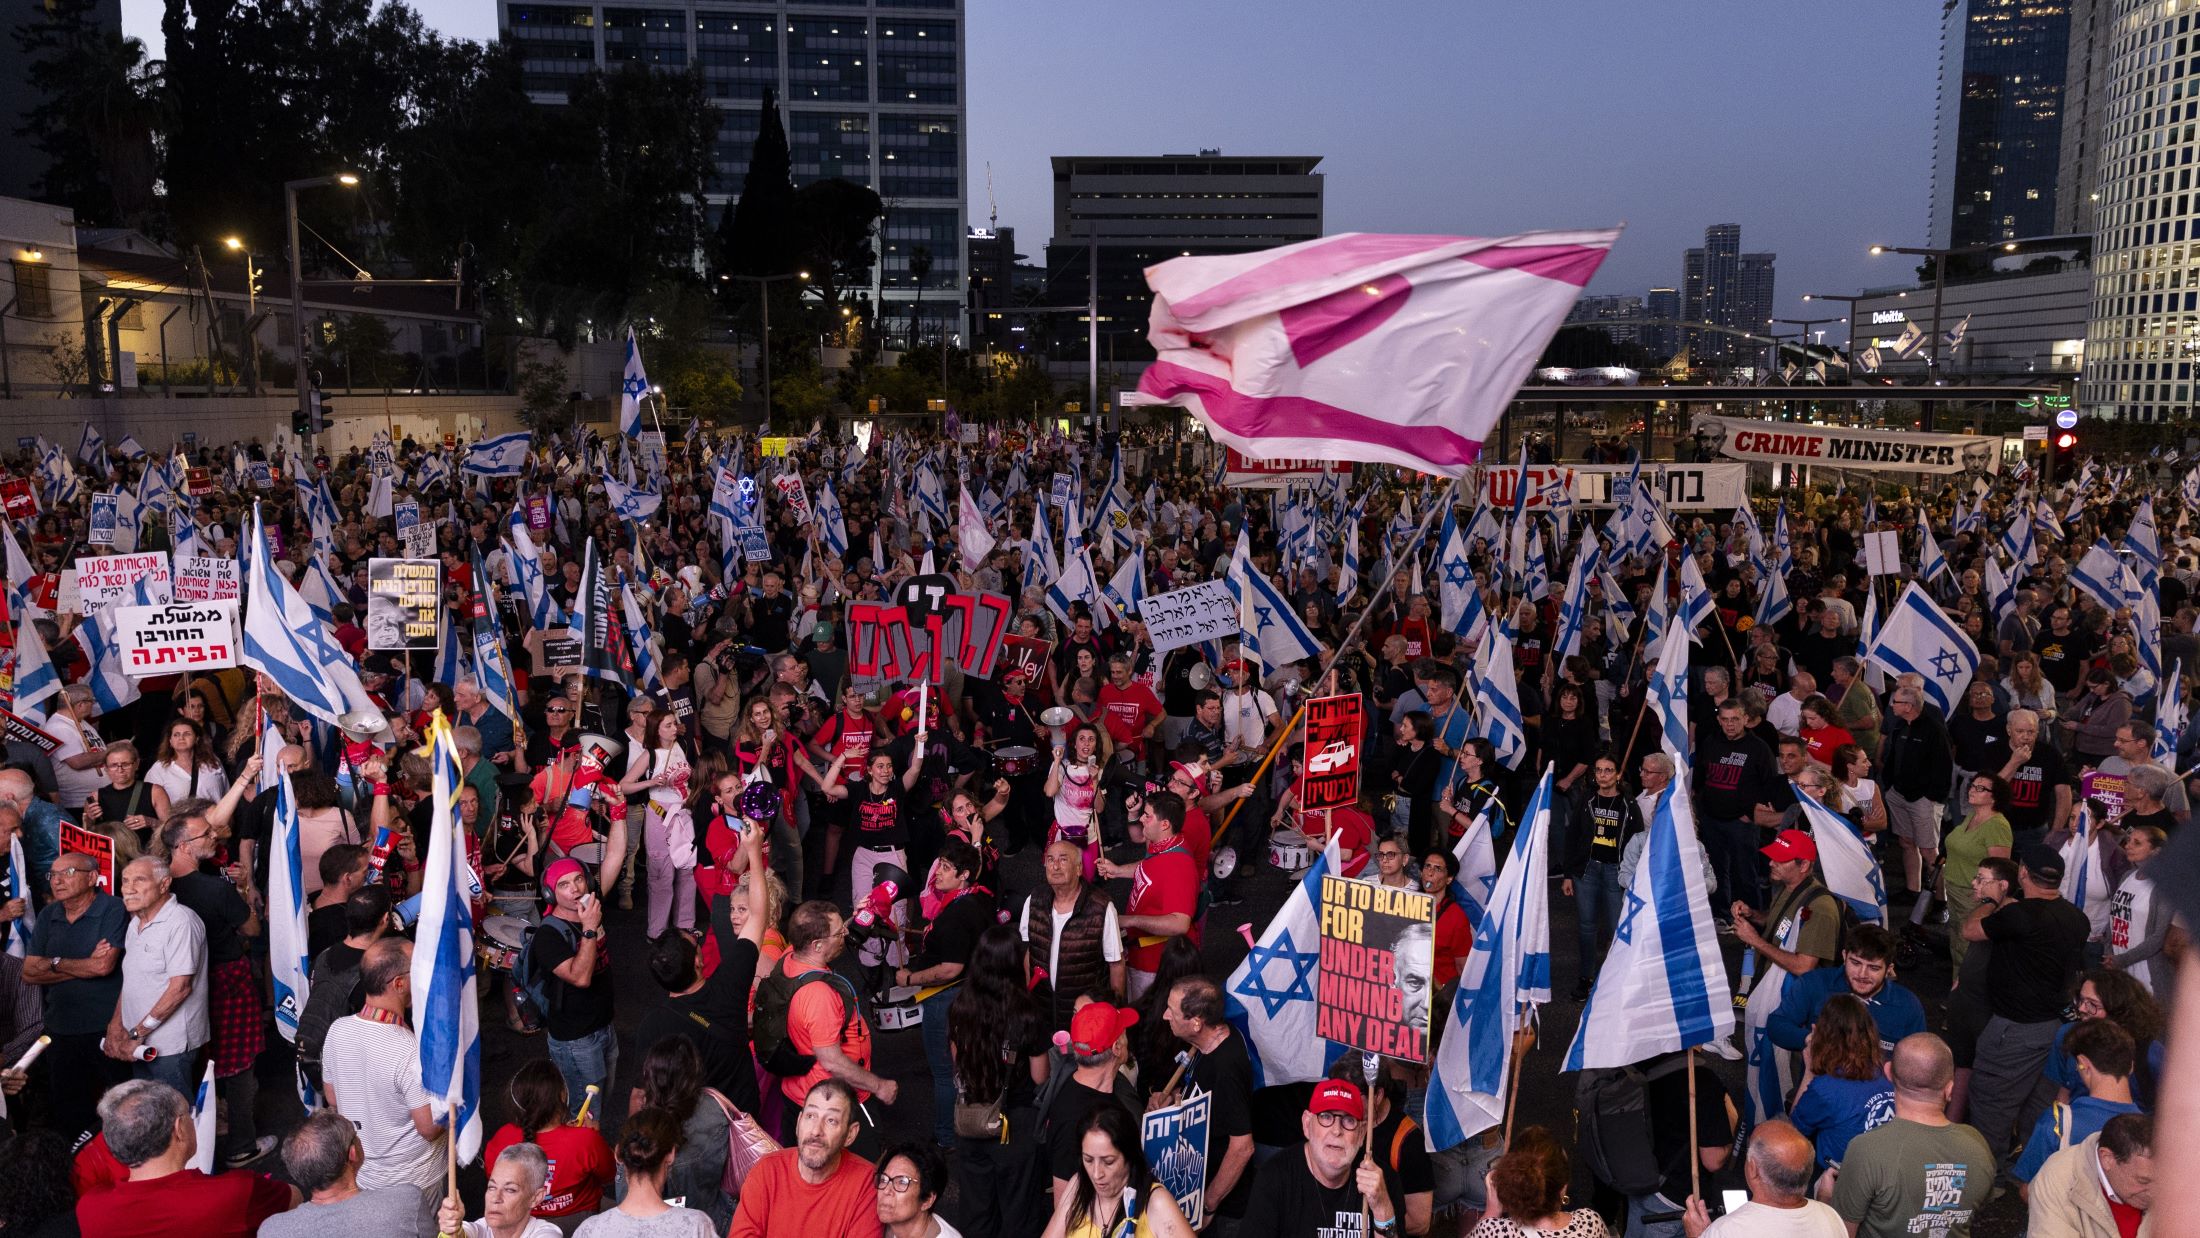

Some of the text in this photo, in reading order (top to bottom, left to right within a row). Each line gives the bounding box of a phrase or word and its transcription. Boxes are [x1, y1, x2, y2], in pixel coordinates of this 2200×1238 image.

[1735, 431, 1955, 468] CRIME MINISTER
[85, 560, 110, 574] שלנו
[393, 564, 436, 579] ממשלת
[147, 605, 223, 626] ממשלת
[405, 622, 436, 637] העם!
[418, 609, 436, 622] את
[135, 628, 205, 648] החורבן
[131, 645, 229, 666] הביתה
[1322, 876, 1432, 923] UR TO BLAME
[1320, 902, 1364, 945] FOR
[1319, 936, 1397, 989] UNDER
[1318, 971, 1404, 1024] MINING
[1316, 1004, 1426, 1063] ANY DEAL
[1145, 1100, 1207, 1141] בחירות
